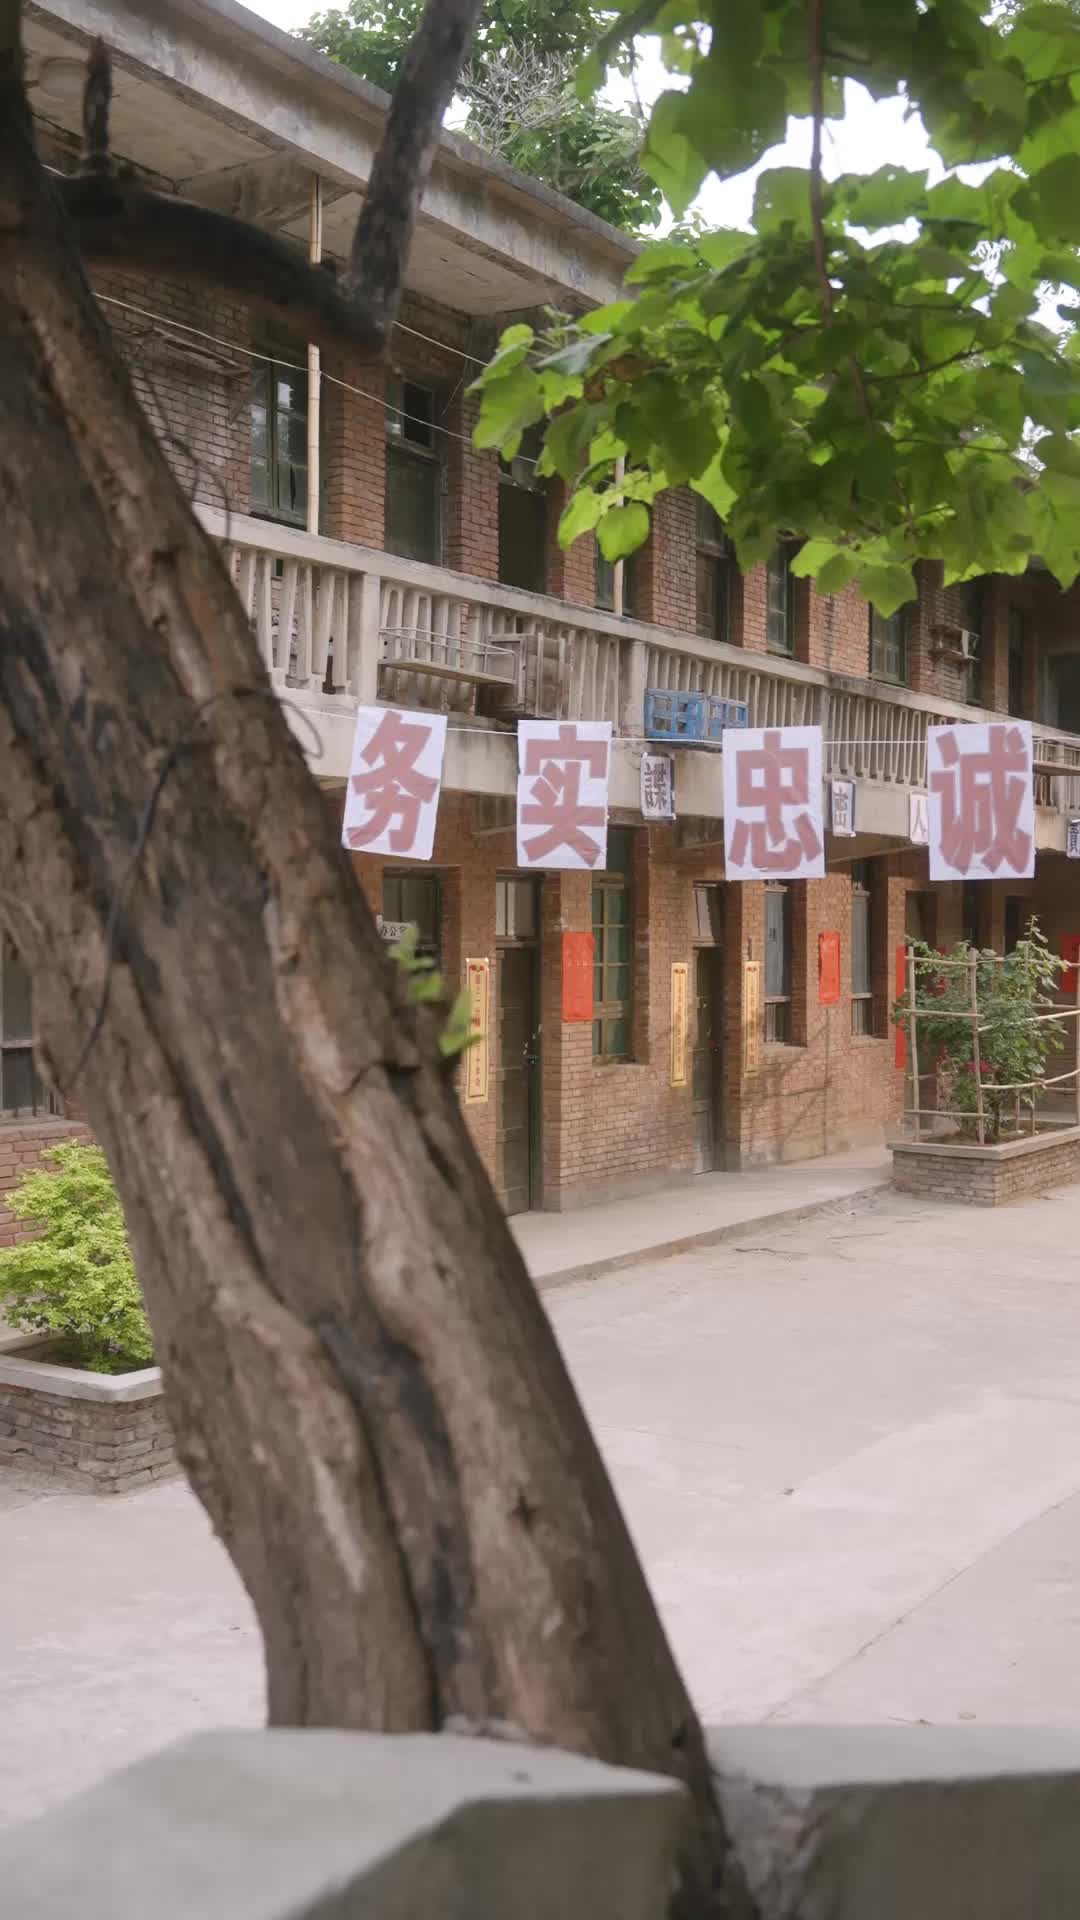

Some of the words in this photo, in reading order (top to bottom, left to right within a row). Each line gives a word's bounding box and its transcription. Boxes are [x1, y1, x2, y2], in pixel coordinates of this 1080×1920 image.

[346, 710, 438, 851] 务
[521, 725, 608, 866] 实
[729, 731, 822, 871] 忠
[931, 725, 1031, 875] 诚
